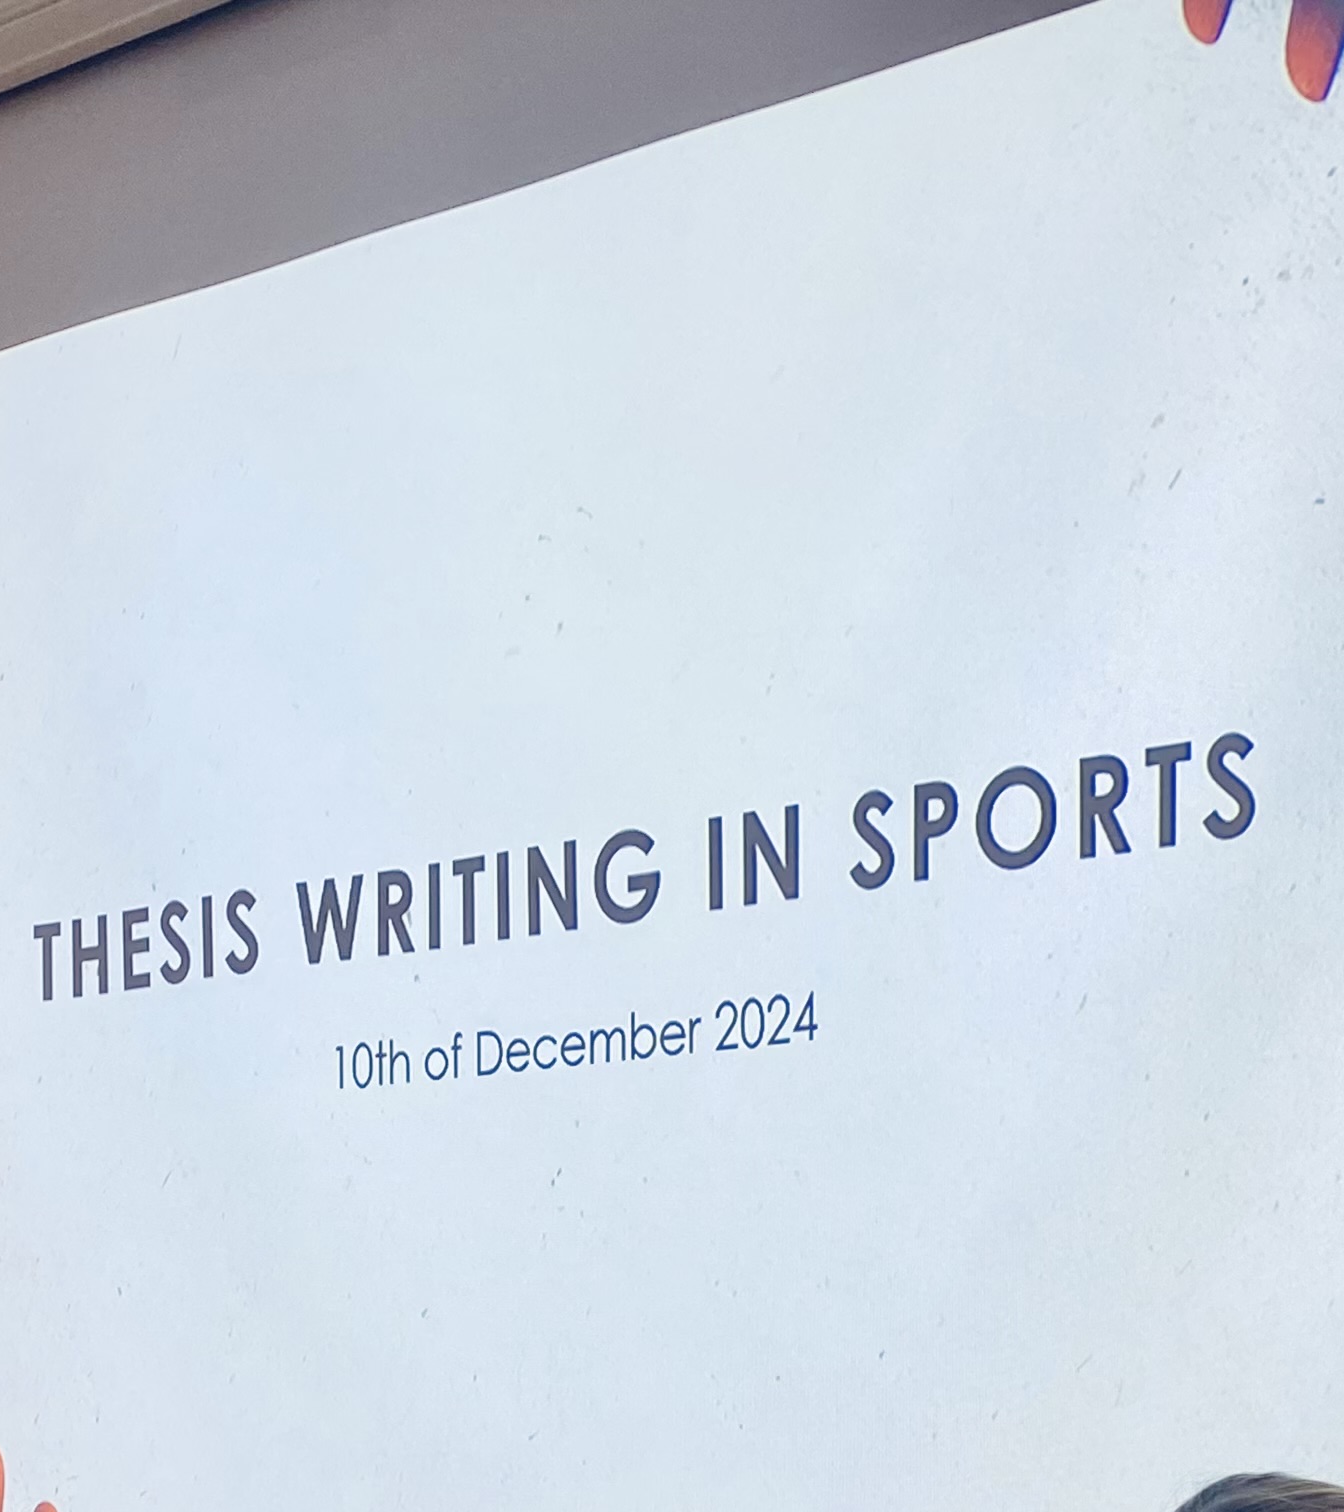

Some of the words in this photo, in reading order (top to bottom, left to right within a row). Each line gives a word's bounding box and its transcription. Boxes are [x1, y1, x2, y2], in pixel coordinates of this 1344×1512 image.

[32, 888, 261, 1002] THESIS
[295, 828, 662, 965] WRITING
[707, 803, 801, 911] IN
[848, 732, 1258, 891] SPORTS
[334, 1039, 412, 1091] 10th
[423, 1030, 465, 1082] of
[475, 1010, 704, 1078] December
[714, 989, 821, 1052] 2024
